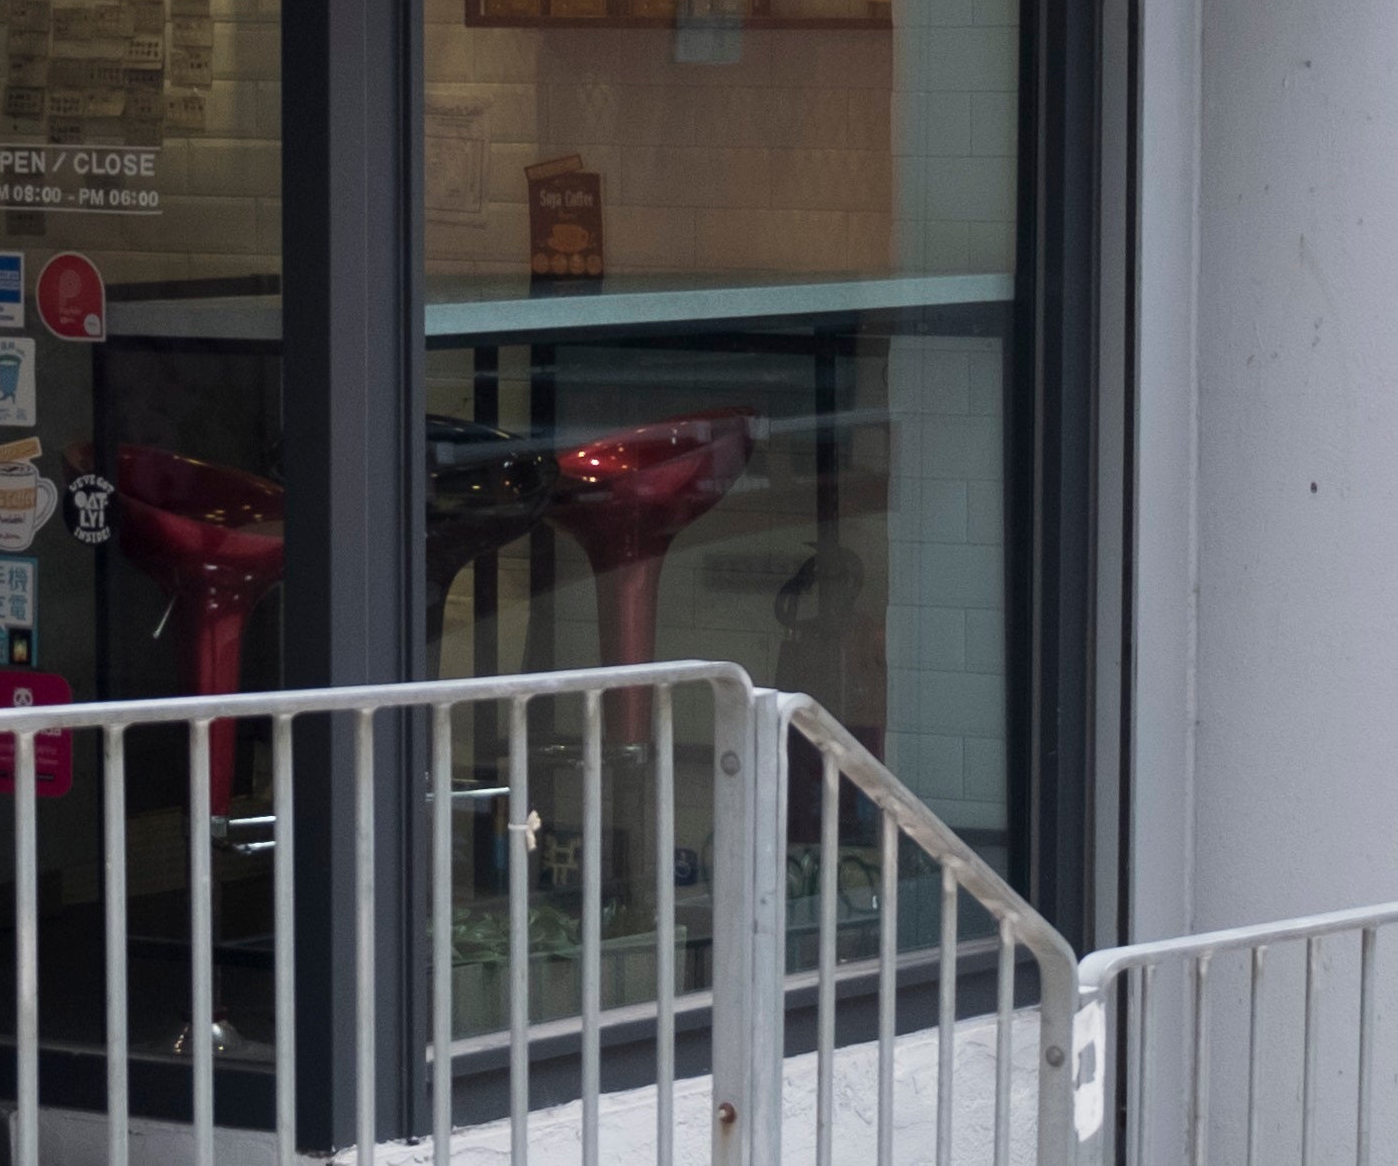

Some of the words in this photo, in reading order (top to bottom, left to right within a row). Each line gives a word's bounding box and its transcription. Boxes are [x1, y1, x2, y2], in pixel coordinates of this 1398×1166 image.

[51, 152, 67, 172] /
[73, 152, 156, 176] CLOSE
[78, 187, 104, 206] PM
[108, 189, 159, 207] 06:00
[564, 189, 594, 208] Coffee
